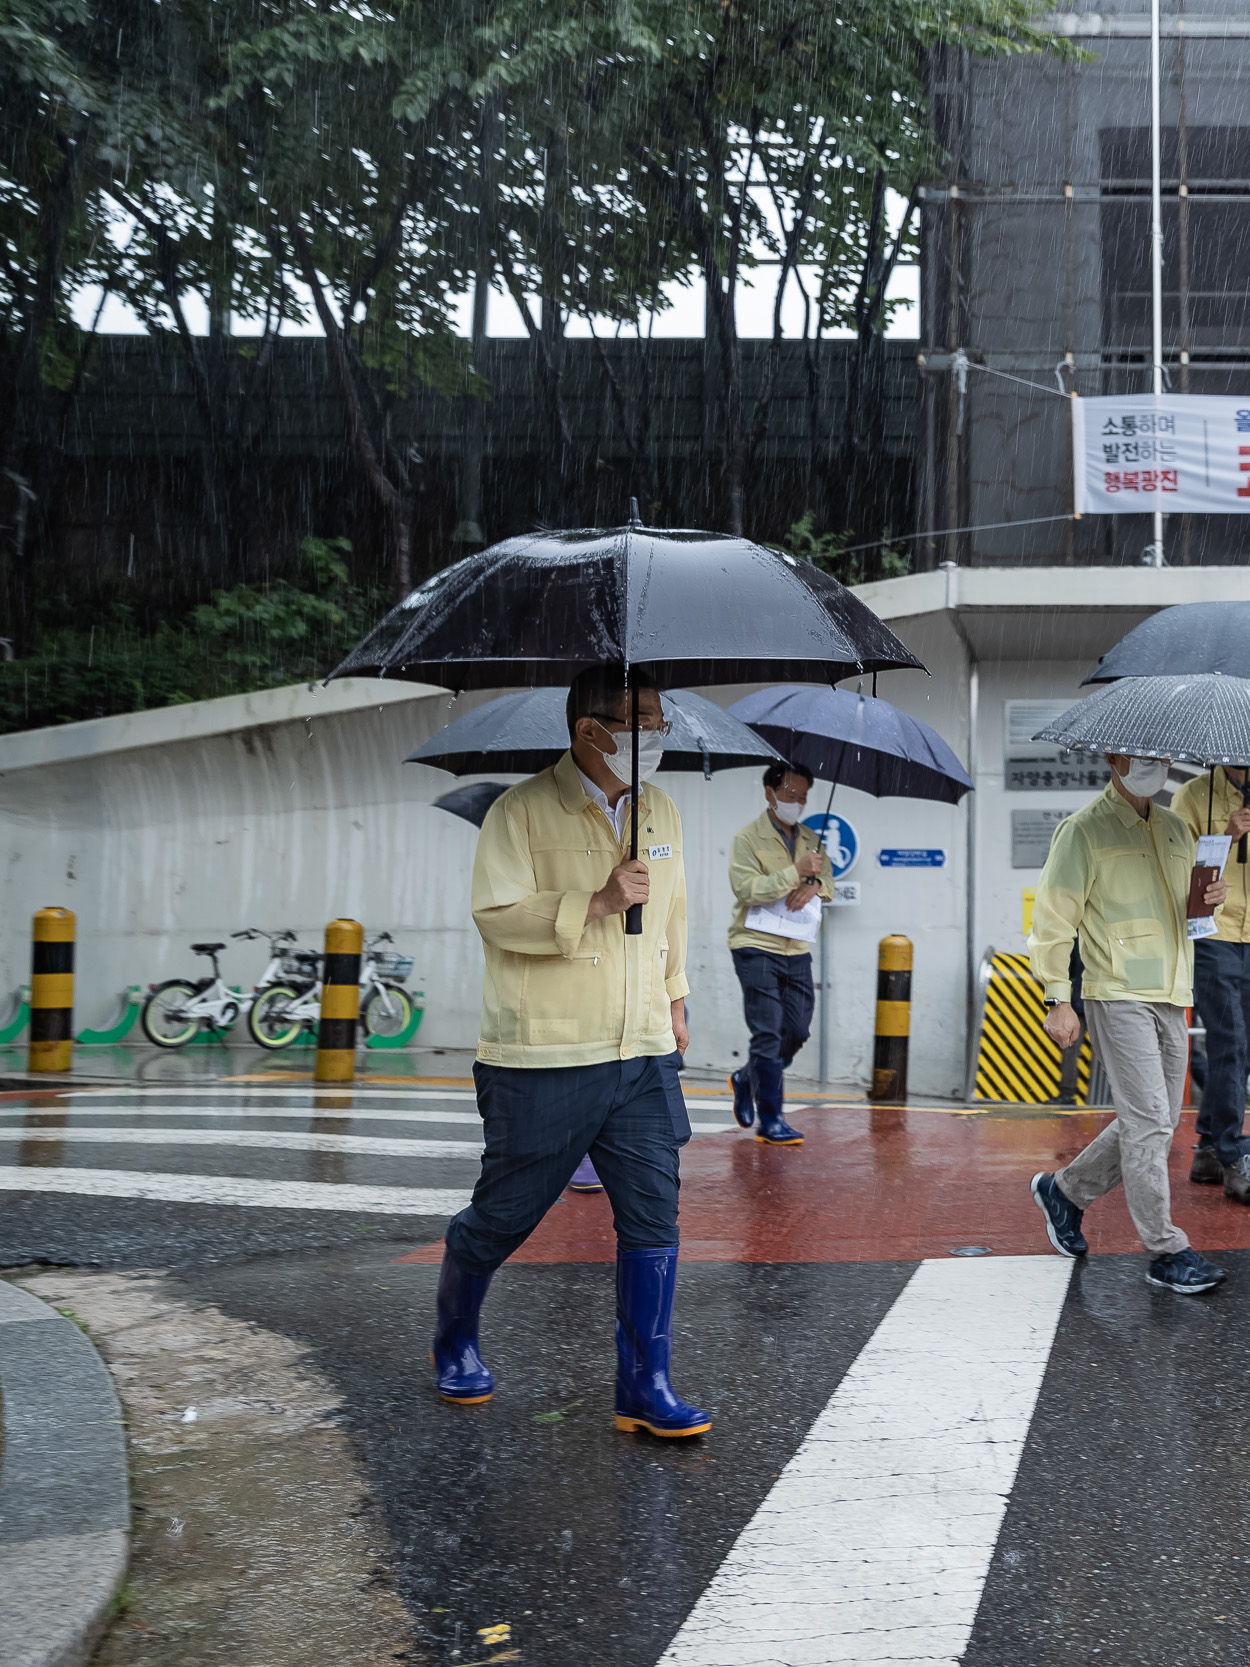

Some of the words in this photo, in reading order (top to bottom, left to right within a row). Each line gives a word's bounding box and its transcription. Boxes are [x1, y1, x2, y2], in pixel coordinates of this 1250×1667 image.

[1101, 414, 1175, 437] 소통하며
[1102, 441, 1178, 464] 발전하는
[1104, 470, 1178, 493] 행복광진
